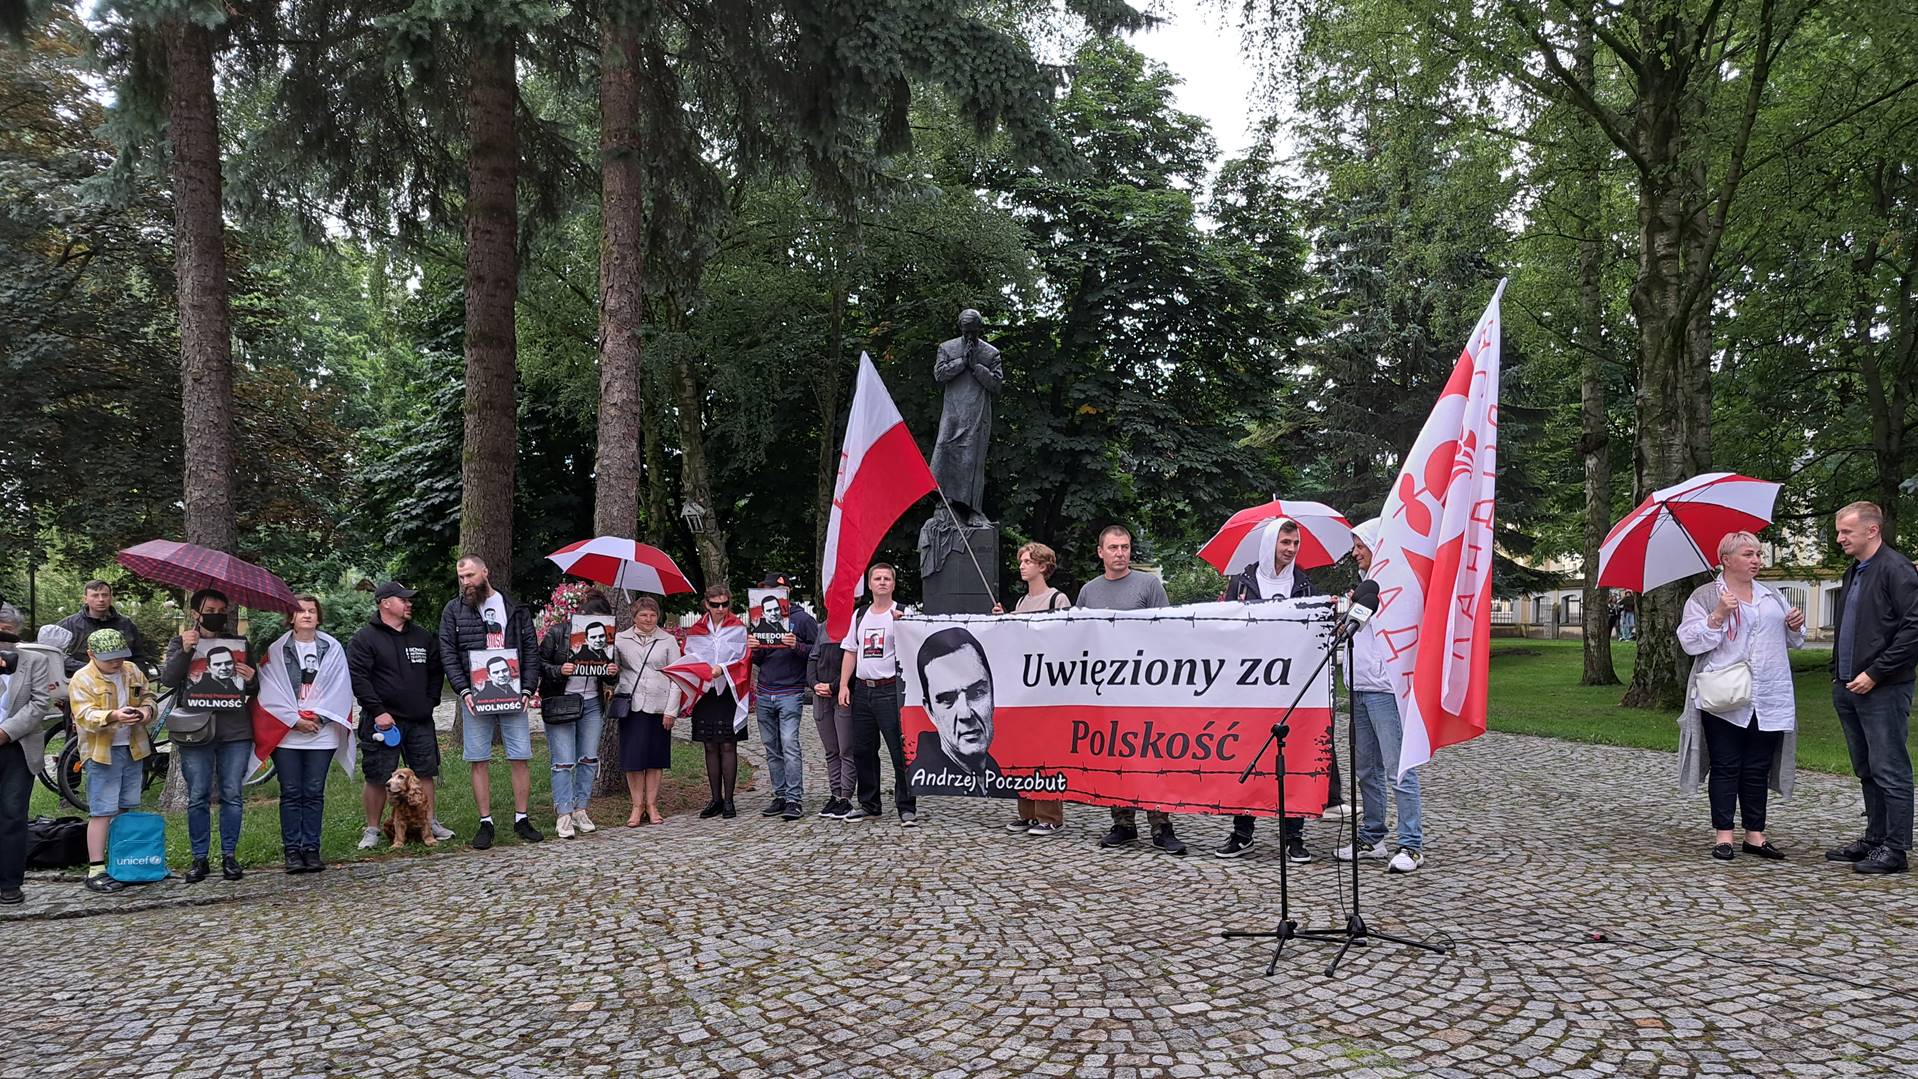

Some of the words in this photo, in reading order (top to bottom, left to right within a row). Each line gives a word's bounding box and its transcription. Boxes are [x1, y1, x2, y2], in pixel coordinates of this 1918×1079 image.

[1022, 649, 1226, 697] Uwięziony
[1235, 657, 1292, 686] za
[187, 698, 242, 708] WOLNOŚĆ
[475, 701, 522, 712] WOLNOŚĆ
[1069, 720, 1240, 761] Polskość
[911, 767, 977, 792] Andrzej
[985, 770, 1067, 791] Poczobut
[116, 855, 149, 866] unicef
